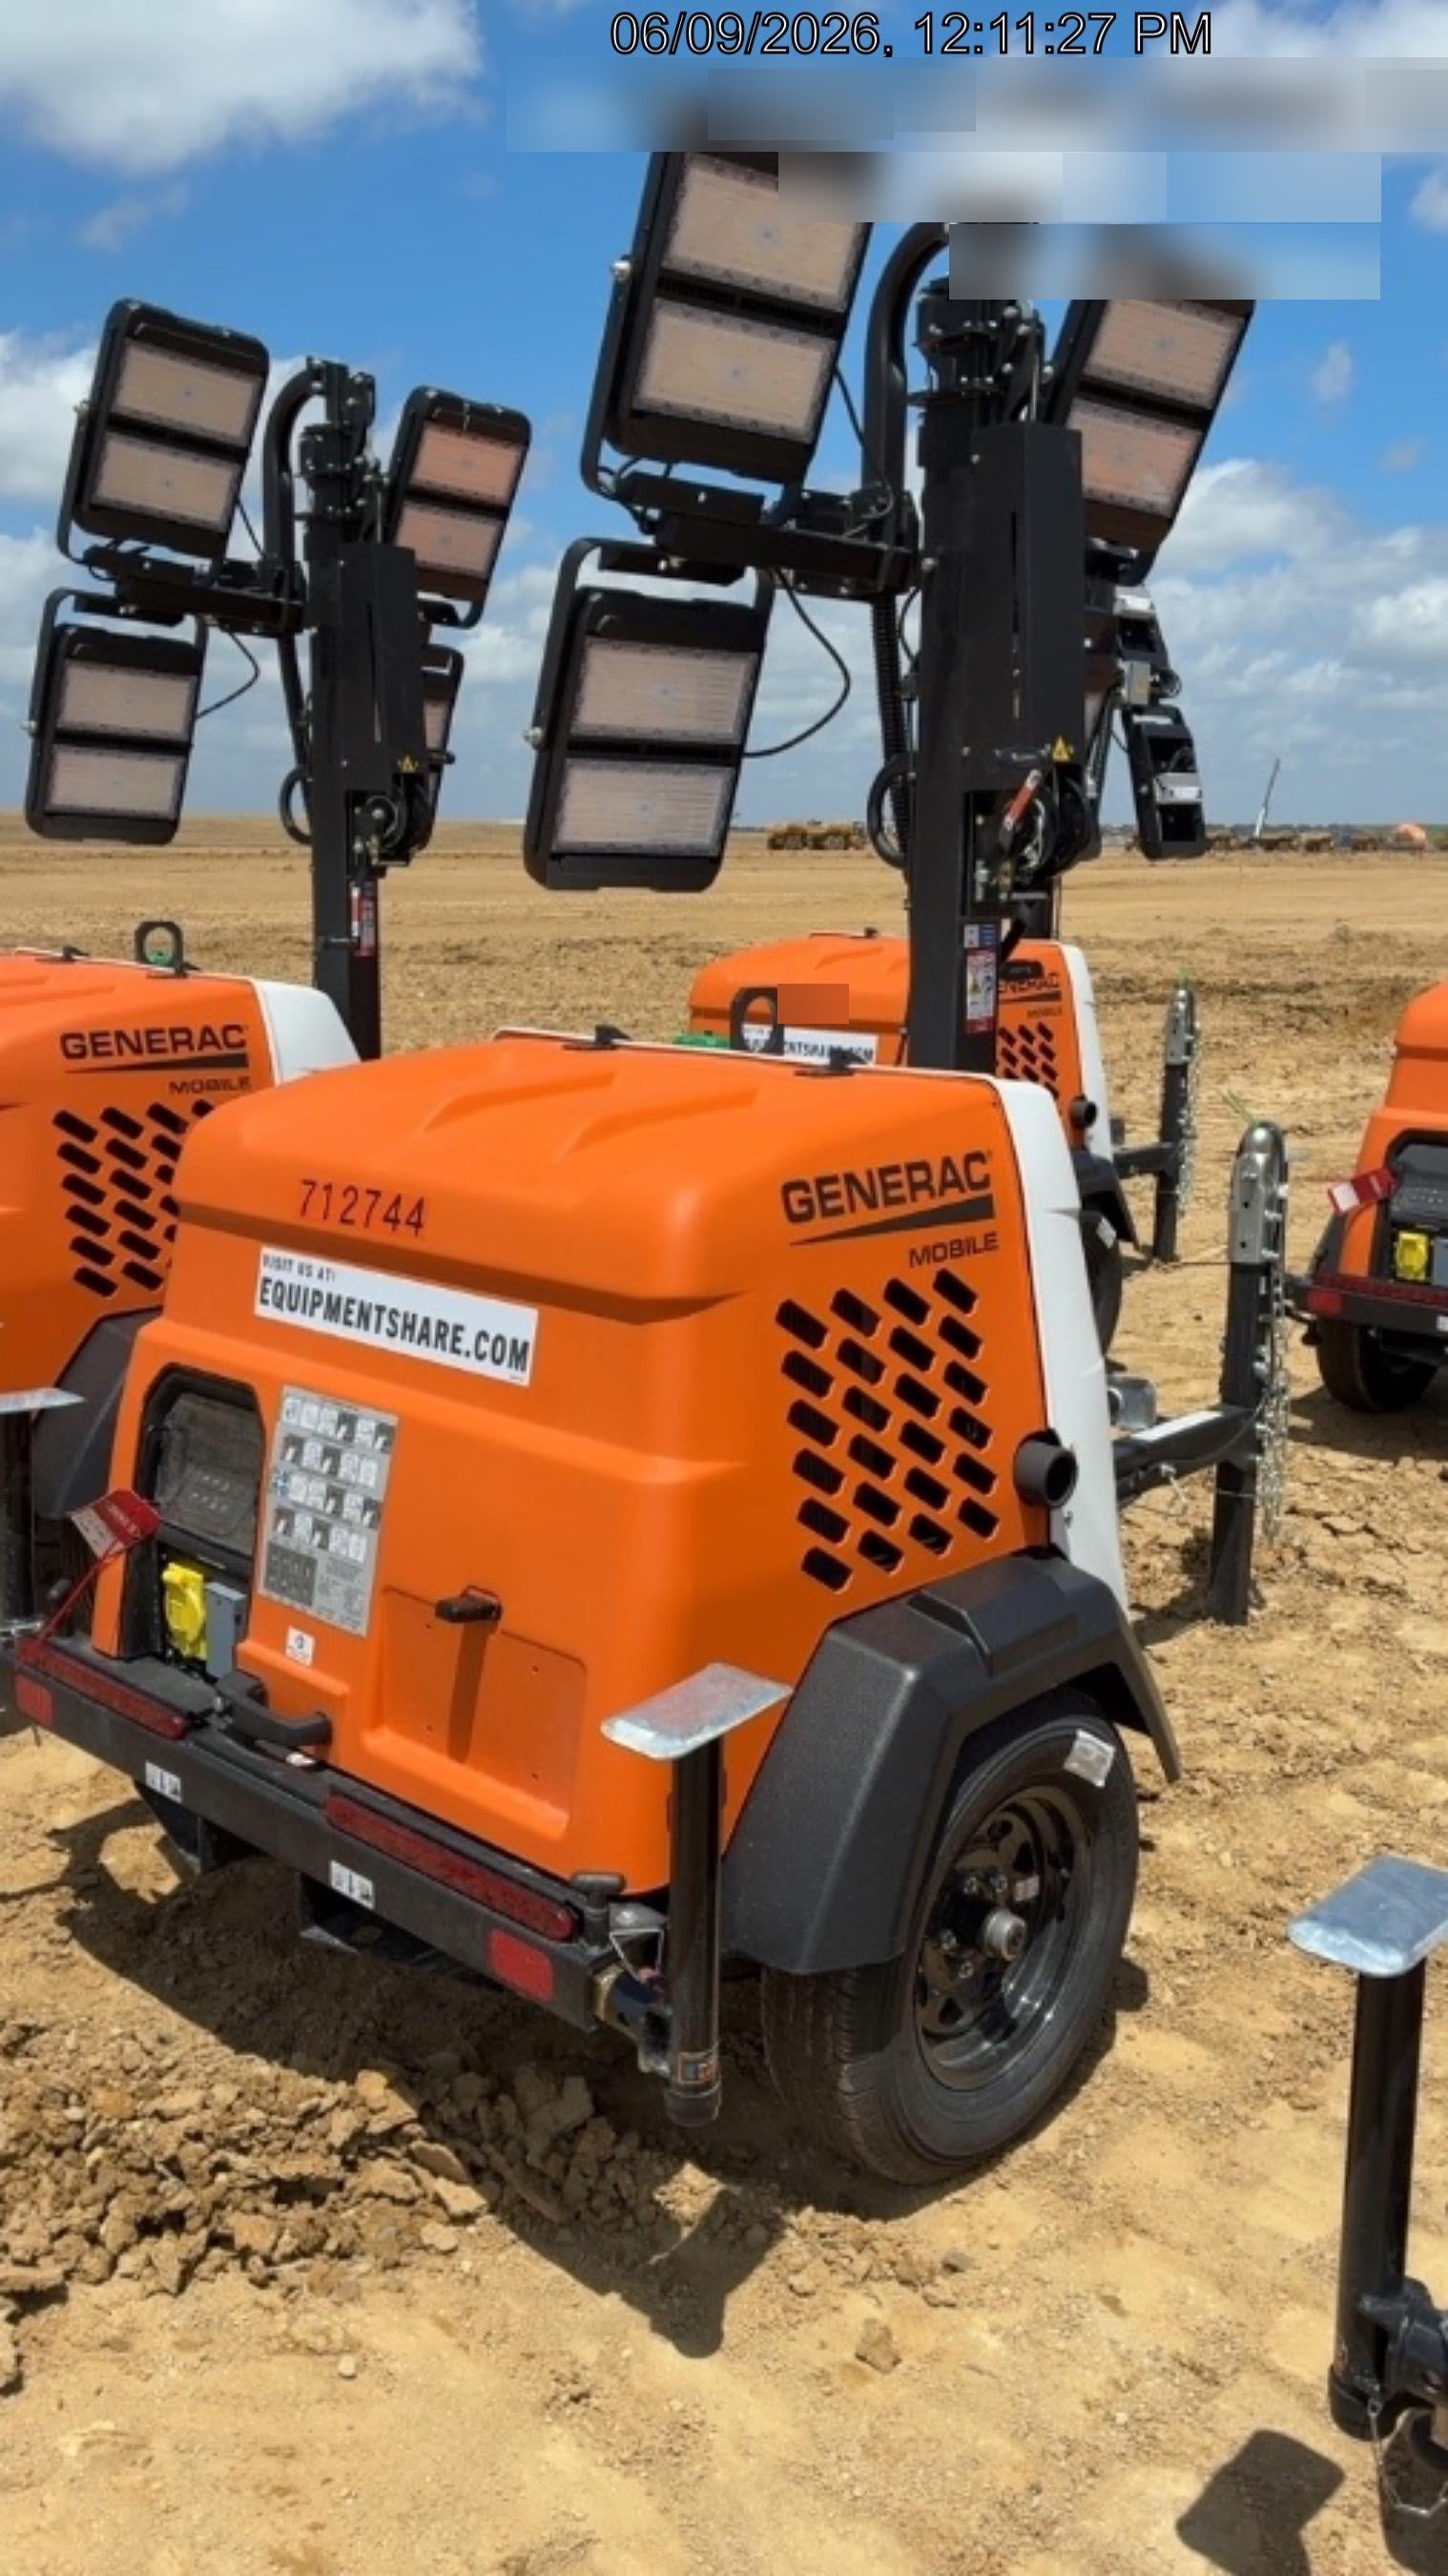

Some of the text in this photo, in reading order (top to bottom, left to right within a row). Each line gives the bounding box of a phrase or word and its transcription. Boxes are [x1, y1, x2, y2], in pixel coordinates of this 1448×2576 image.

[59, 1024, 247, 1061] GENERAC
[168, 1076, 252, 1095] MOBILE
[300, 1178, 425, 1237] 712744
[781, 1150, 991, 1225] GENERAC
[909, 1231, 999, 1268] MOBILE
[259, 1276, 530, 1373] EQUIPMENTSHARE.COM
